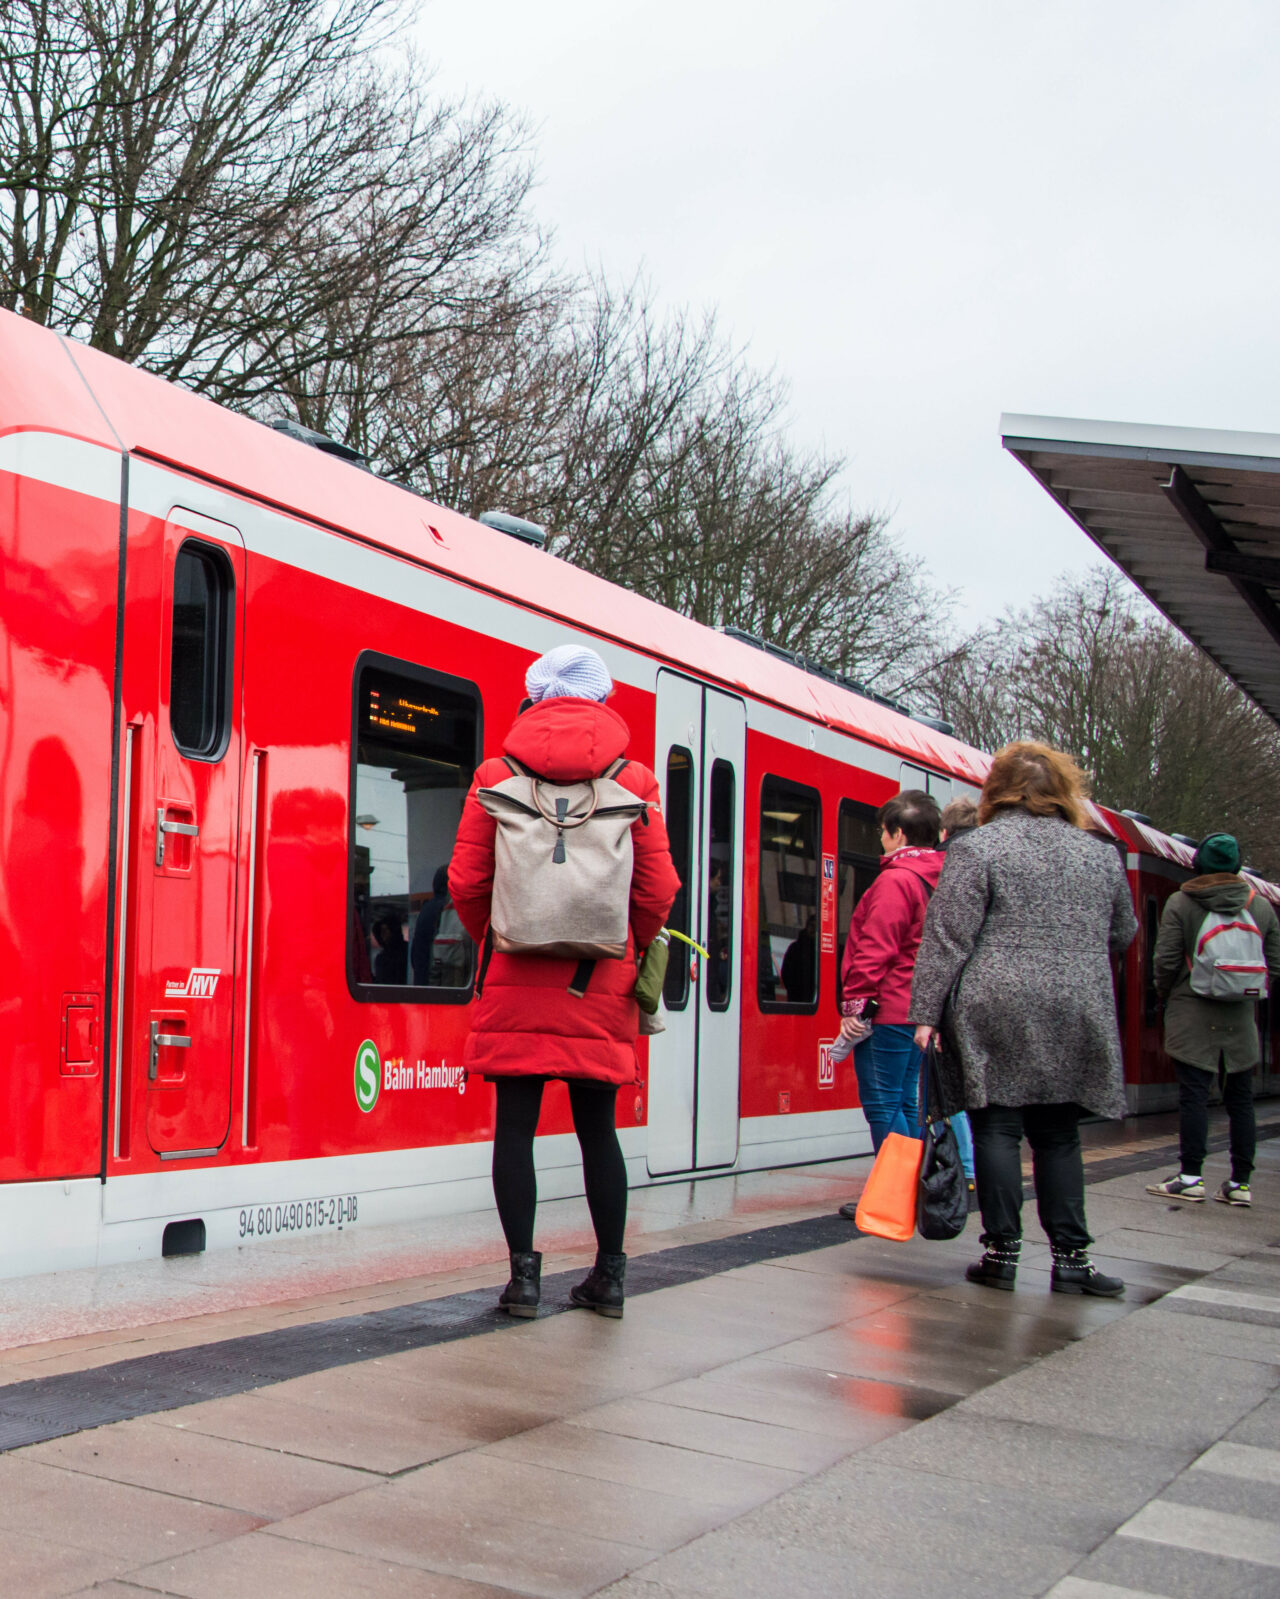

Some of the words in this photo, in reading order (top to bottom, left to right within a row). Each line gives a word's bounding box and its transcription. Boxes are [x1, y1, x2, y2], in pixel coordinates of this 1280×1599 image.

[190, 975, 219, 995] HVV
[359, 1047, 377, 1104] S
[384, 1059, 414, 1090] Bahn
[416, 1059, 465, 1095] Hamburg
[820, 1047, 833, 1080] DB
[239, 1209, 254, 1238] 94
[257, 1207, 272, 1235] 80
[275, 1203, 303, 1233] 0490
[305, 1198, 335, 1228] 615-2
[337, 1195, 358, 1230] D-DB
